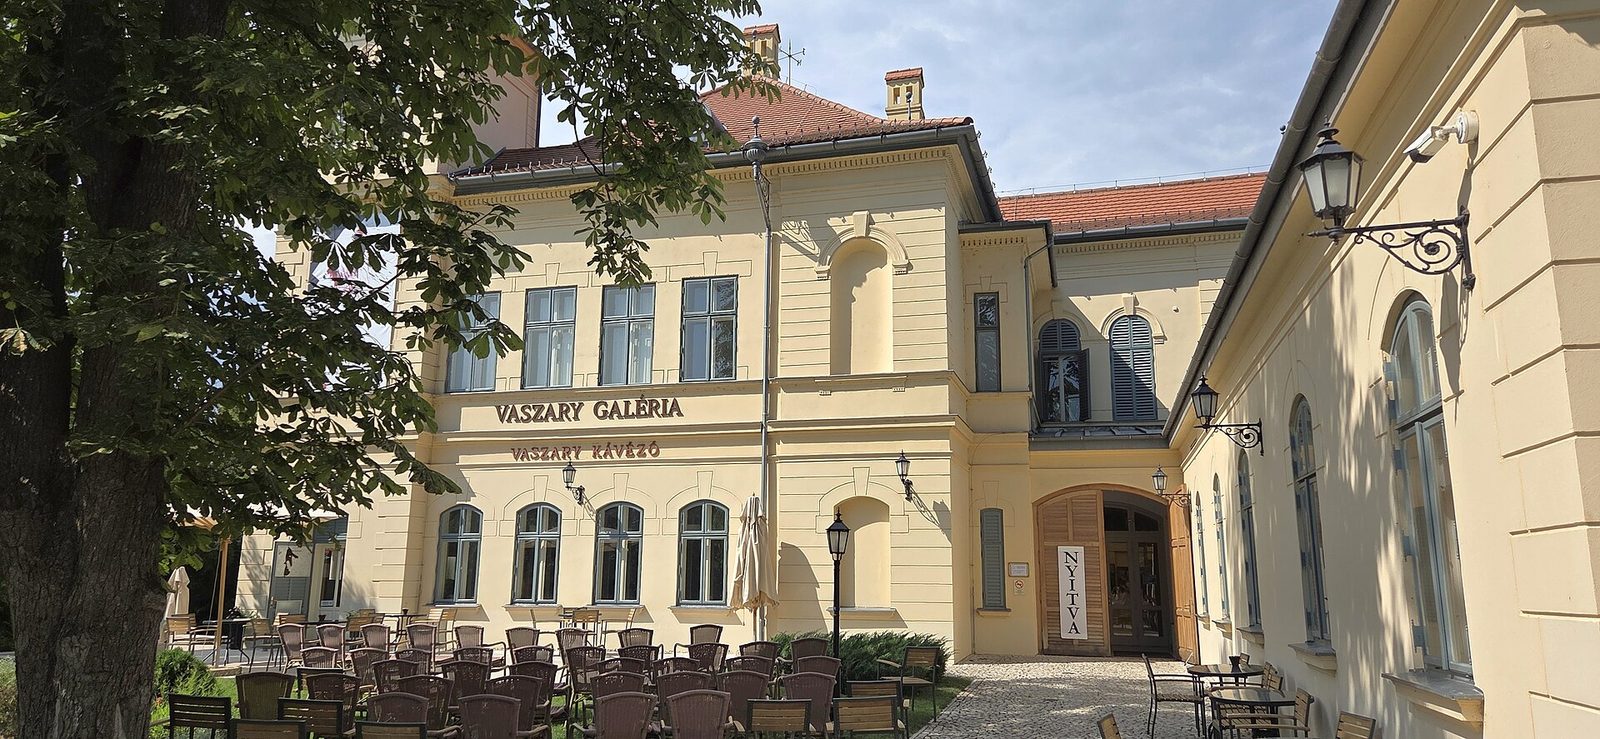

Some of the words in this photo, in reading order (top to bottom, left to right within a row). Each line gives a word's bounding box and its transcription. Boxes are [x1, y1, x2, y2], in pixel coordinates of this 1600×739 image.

[495, 402, 584, 424] VASZARY
[593, 395, 684, 420] GALÉRIA
[511, 446, 582, 462] VASZARY
[592, 441, 661, 460] KÁVÉZÓ
[1064, 551, 1081, 634] NYITVA
